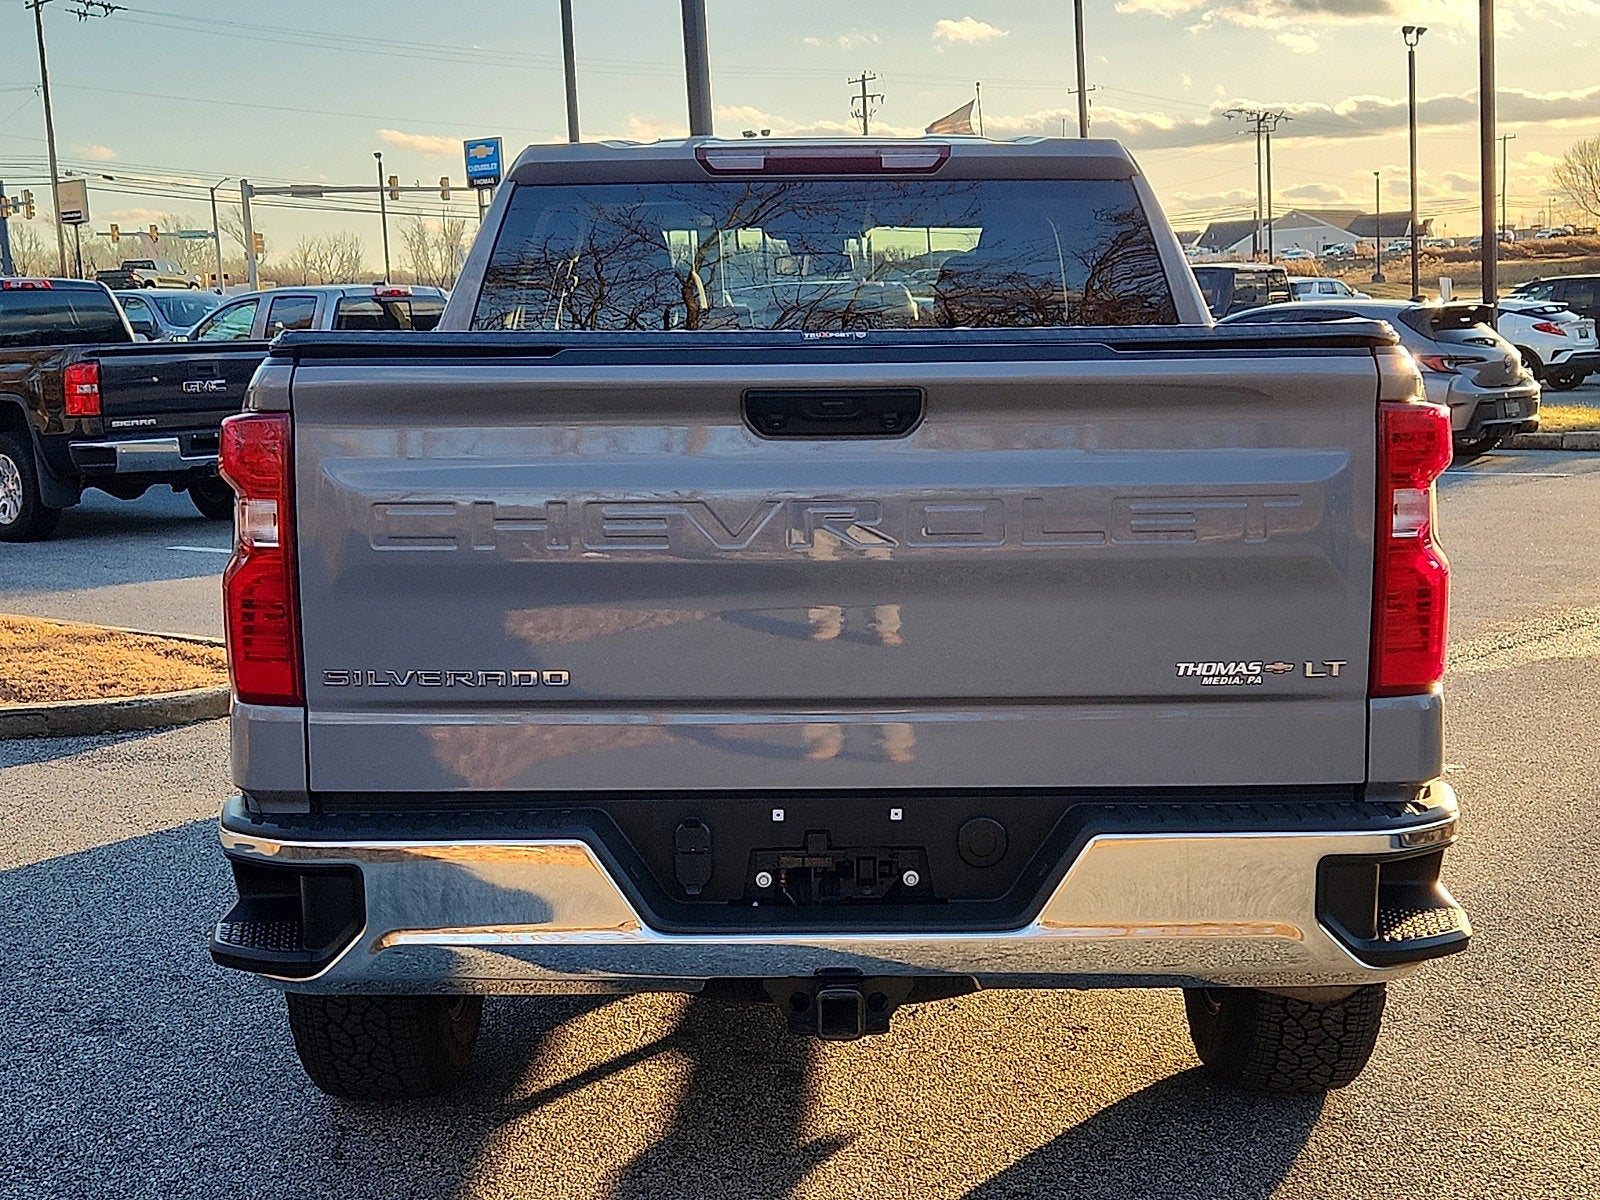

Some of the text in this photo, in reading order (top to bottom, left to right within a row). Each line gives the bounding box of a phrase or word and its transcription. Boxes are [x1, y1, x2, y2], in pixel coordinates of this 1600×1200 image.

[182, 379, 227, 393] GMC
[111, 418, 157, 428] SIERRA
[370, 494, 1304, 552] CHEVROLET
[1175, 661, 1263, 676] THOMAS
[1304, 660, 1348, 678] LT
[322, 669, 572, 688] SILVERADO
[1201, 675, 1263, 686] MEDIA, PA
